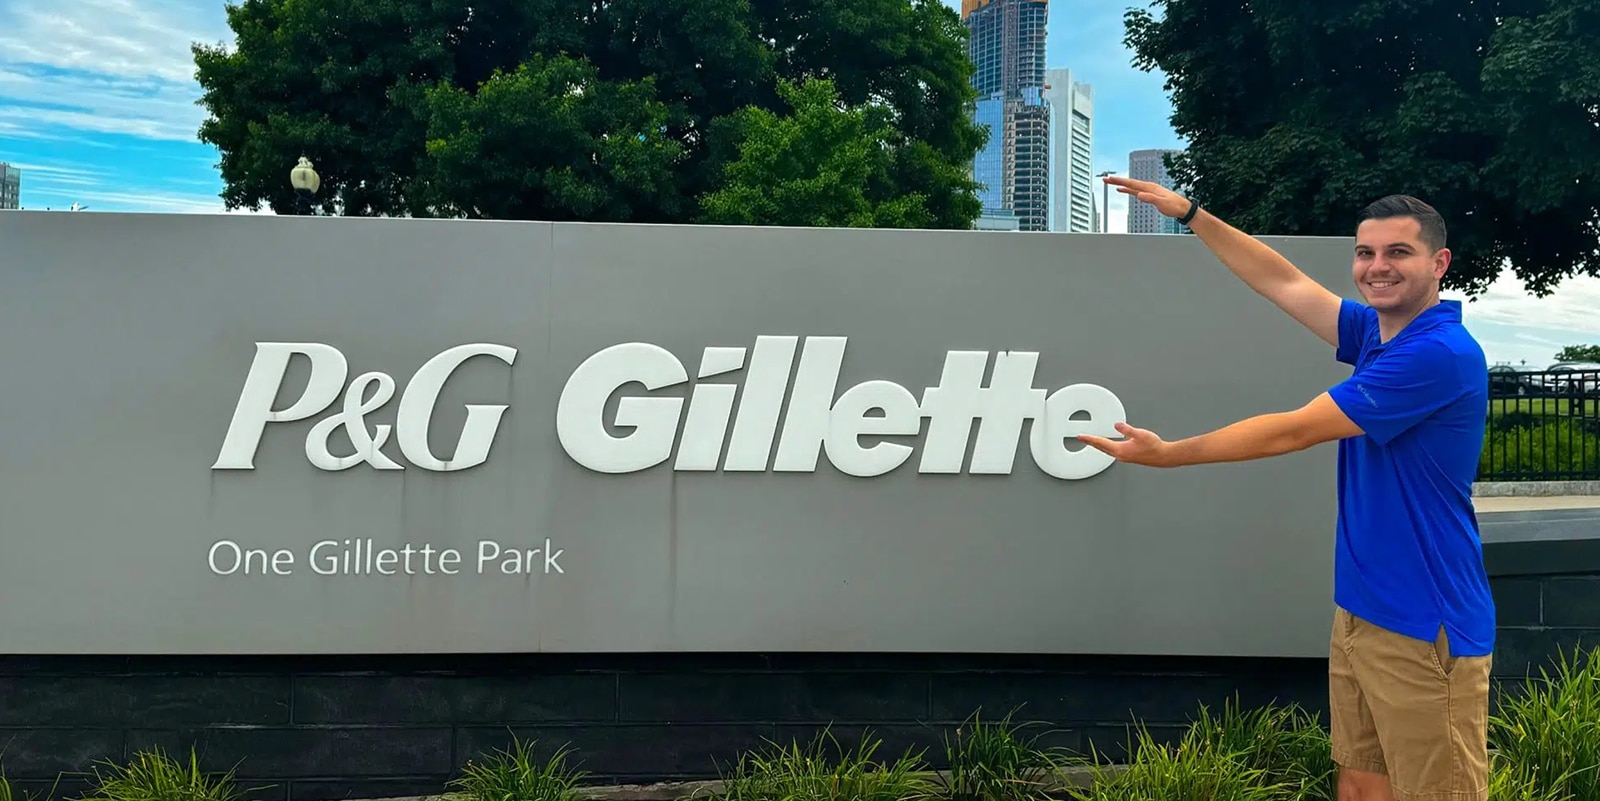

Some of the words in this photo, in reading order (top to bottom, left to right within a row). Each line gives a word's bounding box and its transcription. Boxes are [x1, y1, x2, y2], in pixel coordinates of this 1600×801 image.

[210, 341, 518, 473] P&G
[556, 335, 1127, 480] Gillette
[208, 540, 295, 576] One
[309, 538, 461, 576] Gillette
[477, 538, 564, 575] Park
